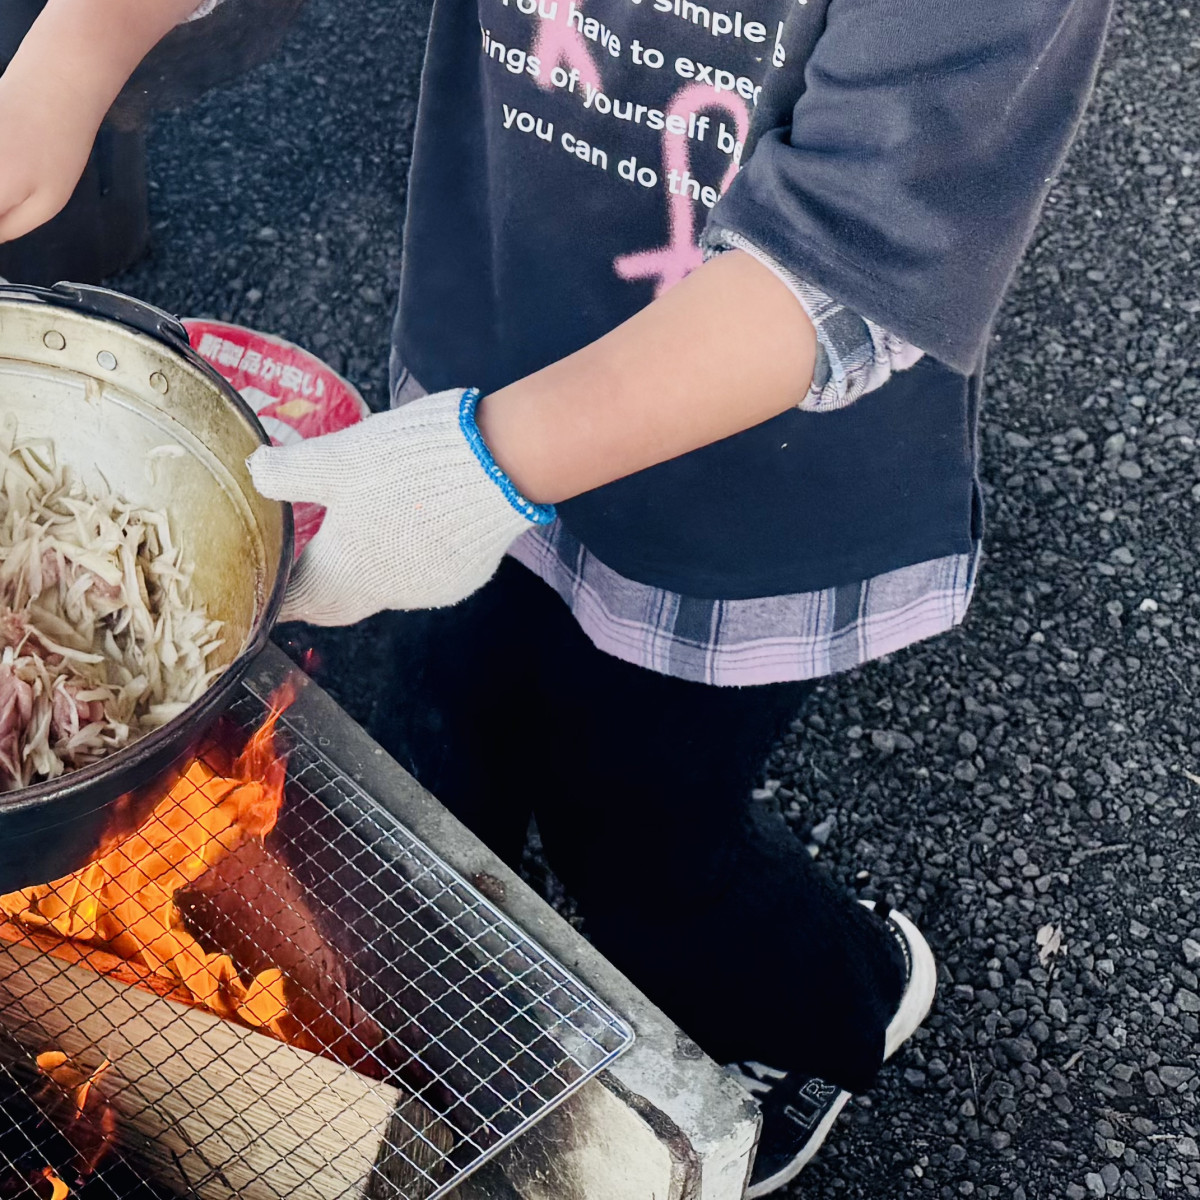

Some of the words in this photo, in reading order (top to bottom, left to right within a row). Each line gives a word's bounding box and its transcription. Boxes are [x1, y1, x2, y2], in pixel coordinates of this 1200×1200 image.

[482, 28, 542, 78] ings
[550, 66, 581, 93] of
[583, 81, 710, 141] yourself
[566, 2, 621, 58] have
[630, 39, 665, 69] to
[502, 103, 554, 142] you
[561, 132, 608, 170] can
[617, 156, 658, 188] do
[668, 168, 721, 209] the
